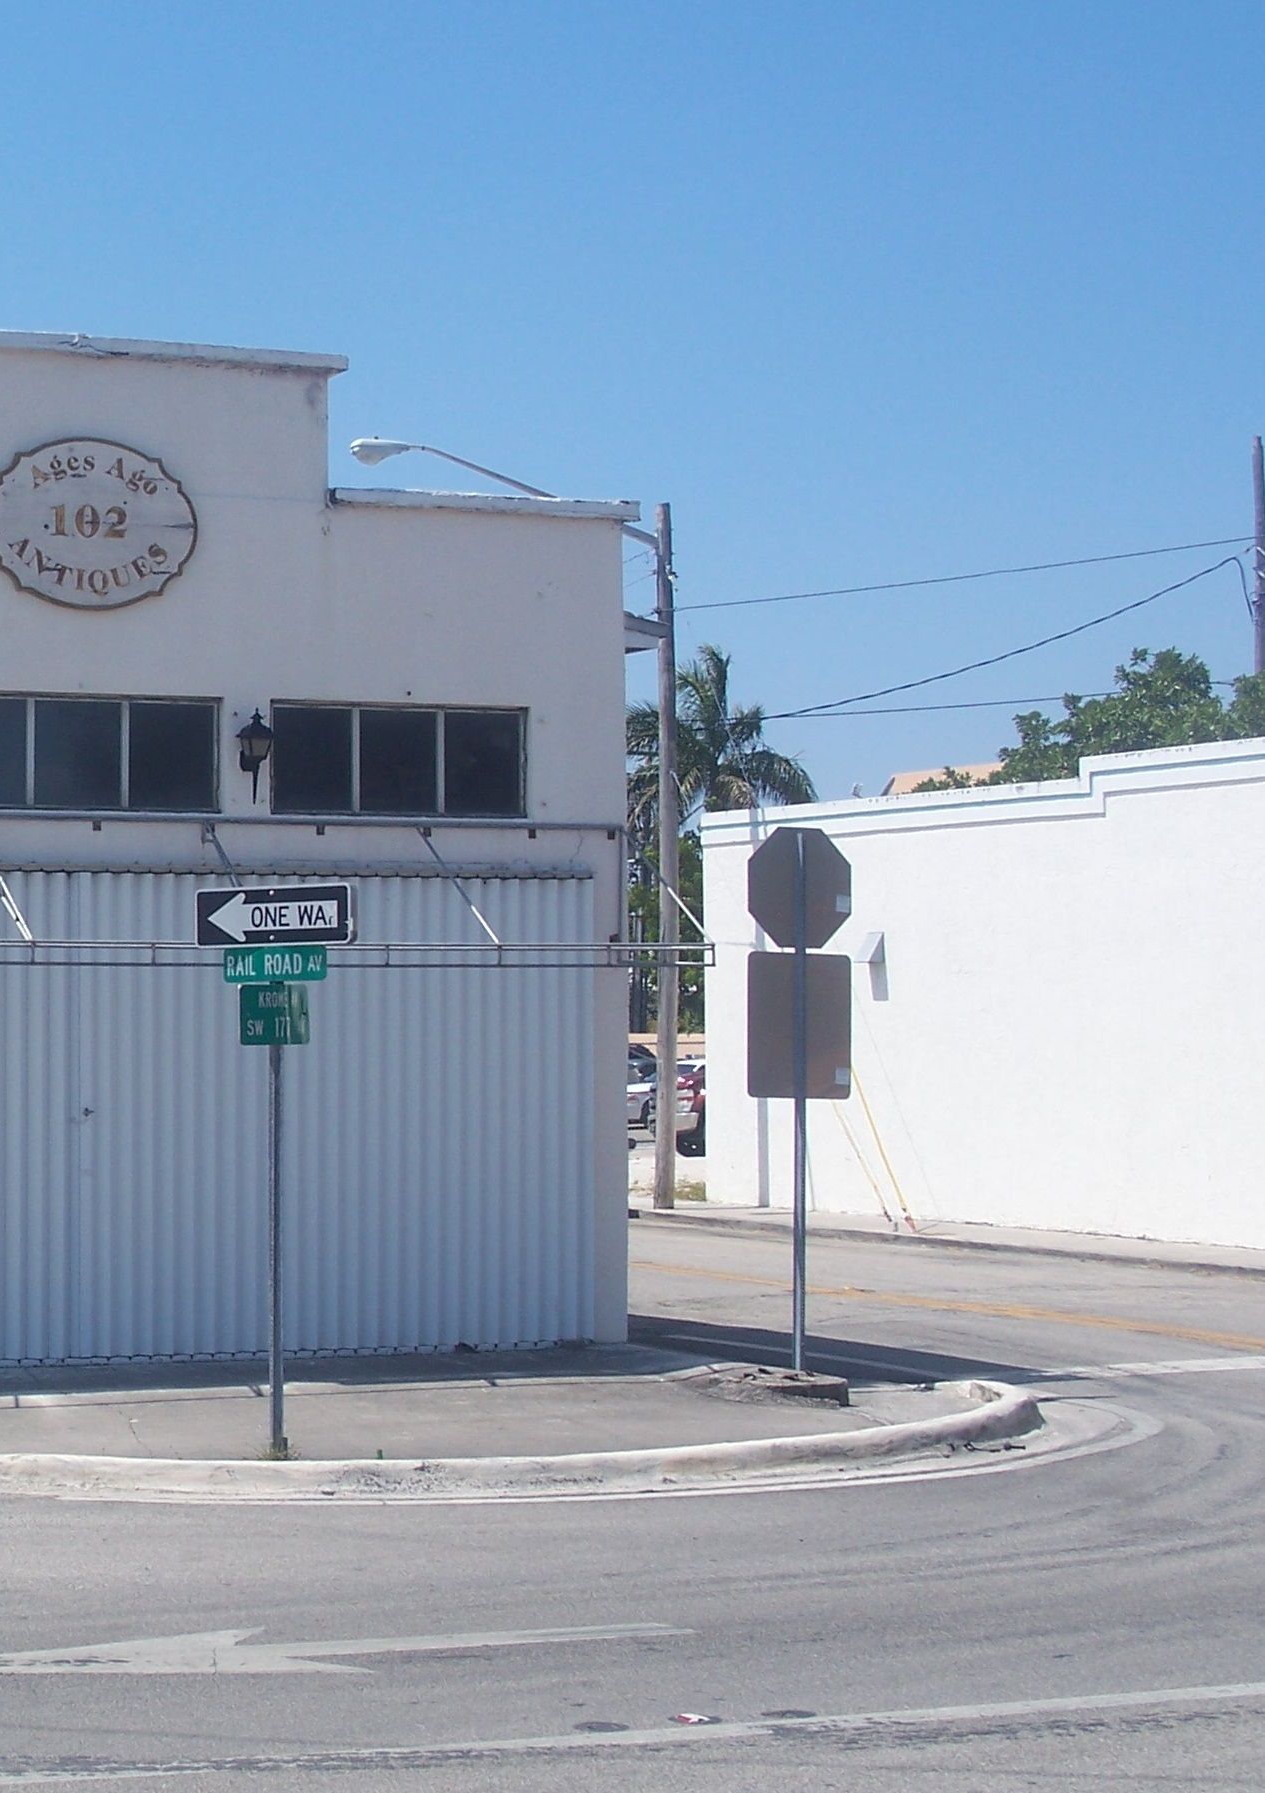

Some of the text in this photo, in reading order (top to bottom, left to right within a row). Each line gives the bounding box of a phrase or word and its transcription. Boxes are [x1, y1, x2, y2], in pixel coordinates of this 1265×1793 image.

[31, 455, 158, 495] Ages Ago
[50, 503, 128, 539] 102
[7, 538, 168, 596] ANTIQUES
[251, 905, 290, 928] ONE
[226, 953, 323, 977] RAIL ROAD AV
[247, 1019, 263, 1037] SW
